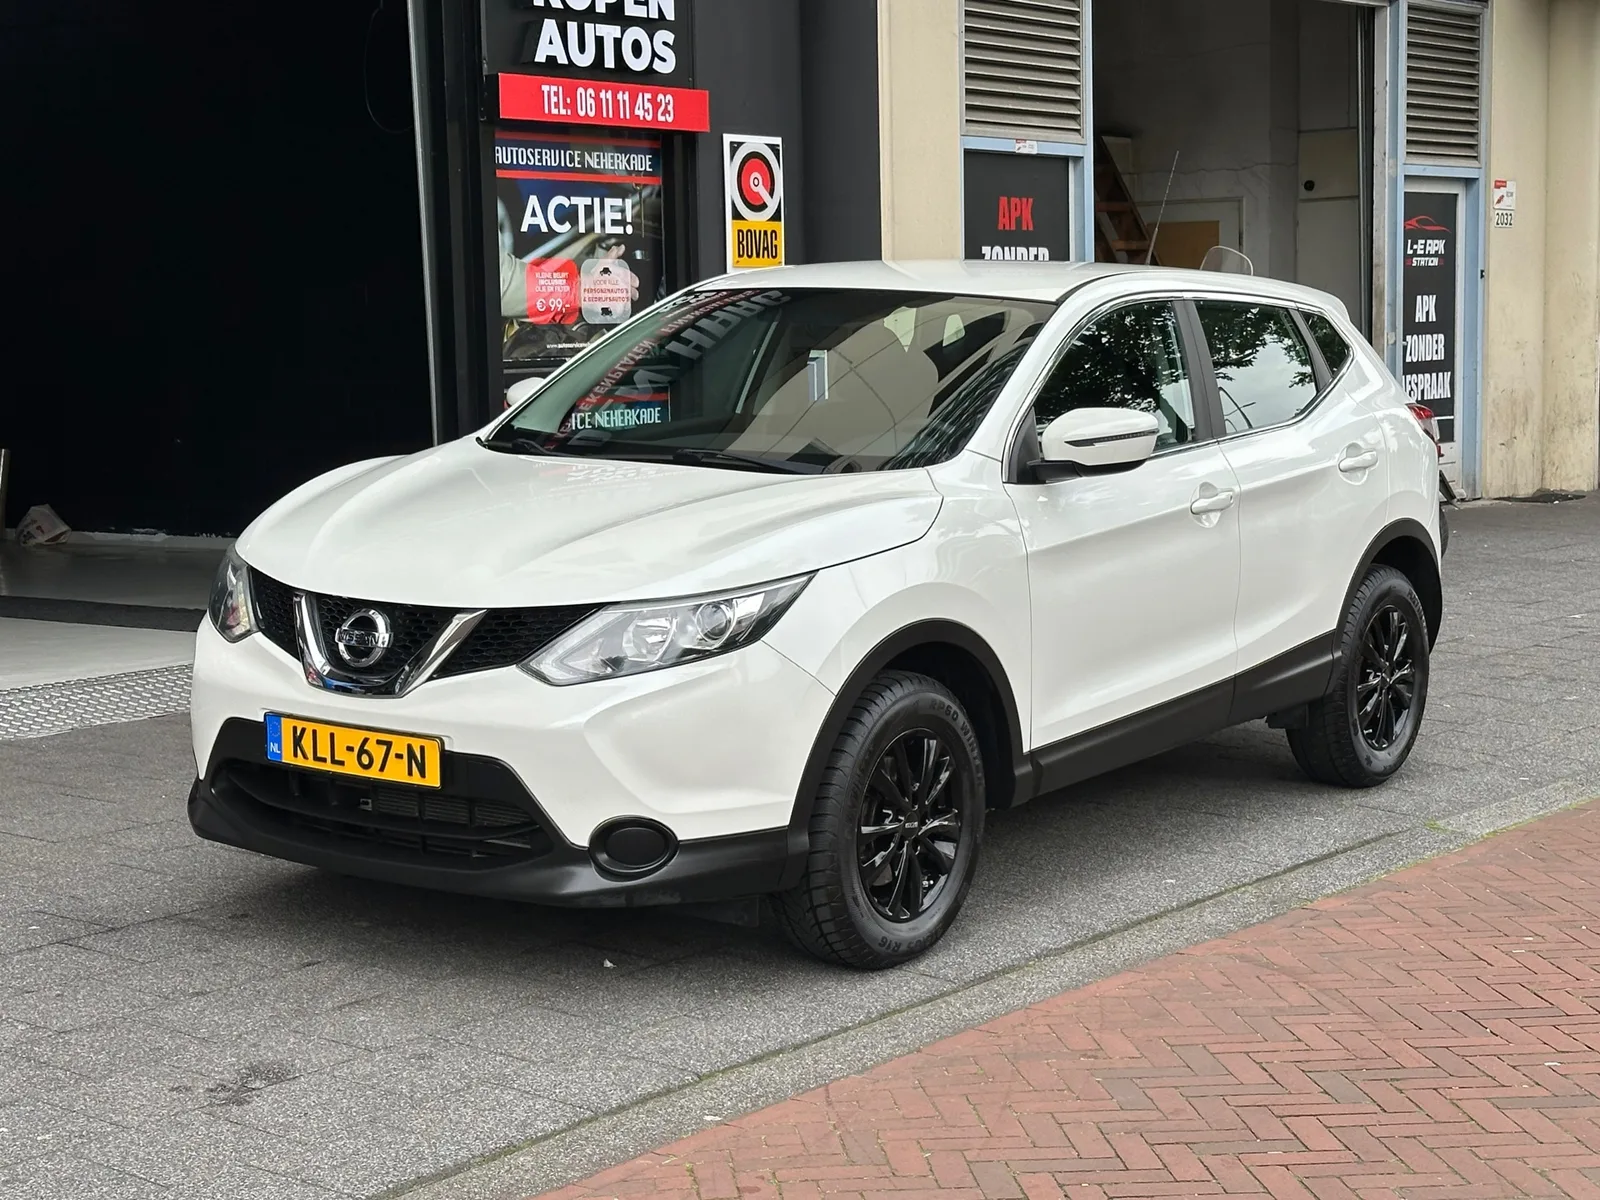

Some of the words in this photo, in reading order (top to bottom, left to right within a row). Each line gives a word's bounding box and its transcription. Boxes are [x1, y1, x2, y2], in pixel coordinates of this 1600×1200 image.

[534, 18, 677, 75] AUTOS
[541, 84, 571, 116] TEL:
[576, 87, 596, 118] 06
[599, 89, 613, 119] 11
[616, 91, 631, 121] 11
[634, 92, 653, 122] 45
[656, 93, 675, 124] 23
[495, 145, 582, 168] AUTOSERVICE
[584, 150, 653, 172] NEHERKADE
[520, 195, 634, 235] ACTIE!
[997, 196, 1034, 231] APK
[1495, 212, 1514, 226] 2032
[737, 229, 778, 260] BOVAG
[1406, 239, 1425, 255] L-E
[1425, 239, 1446, 255] APK
[1412, 257, 1439, 267] STATION
[536, 299, 546, 311] €
[1415, 295, 1436, 322] APK
[1405, 333, 1445, 362] ZONDER
[594, 407, 662, 428] NEHERKADE
[338, 629, 379, 646] NISSAN
[269, 741, 281, 754] NL
[291, 725, 427, 779] KLL-67-N
